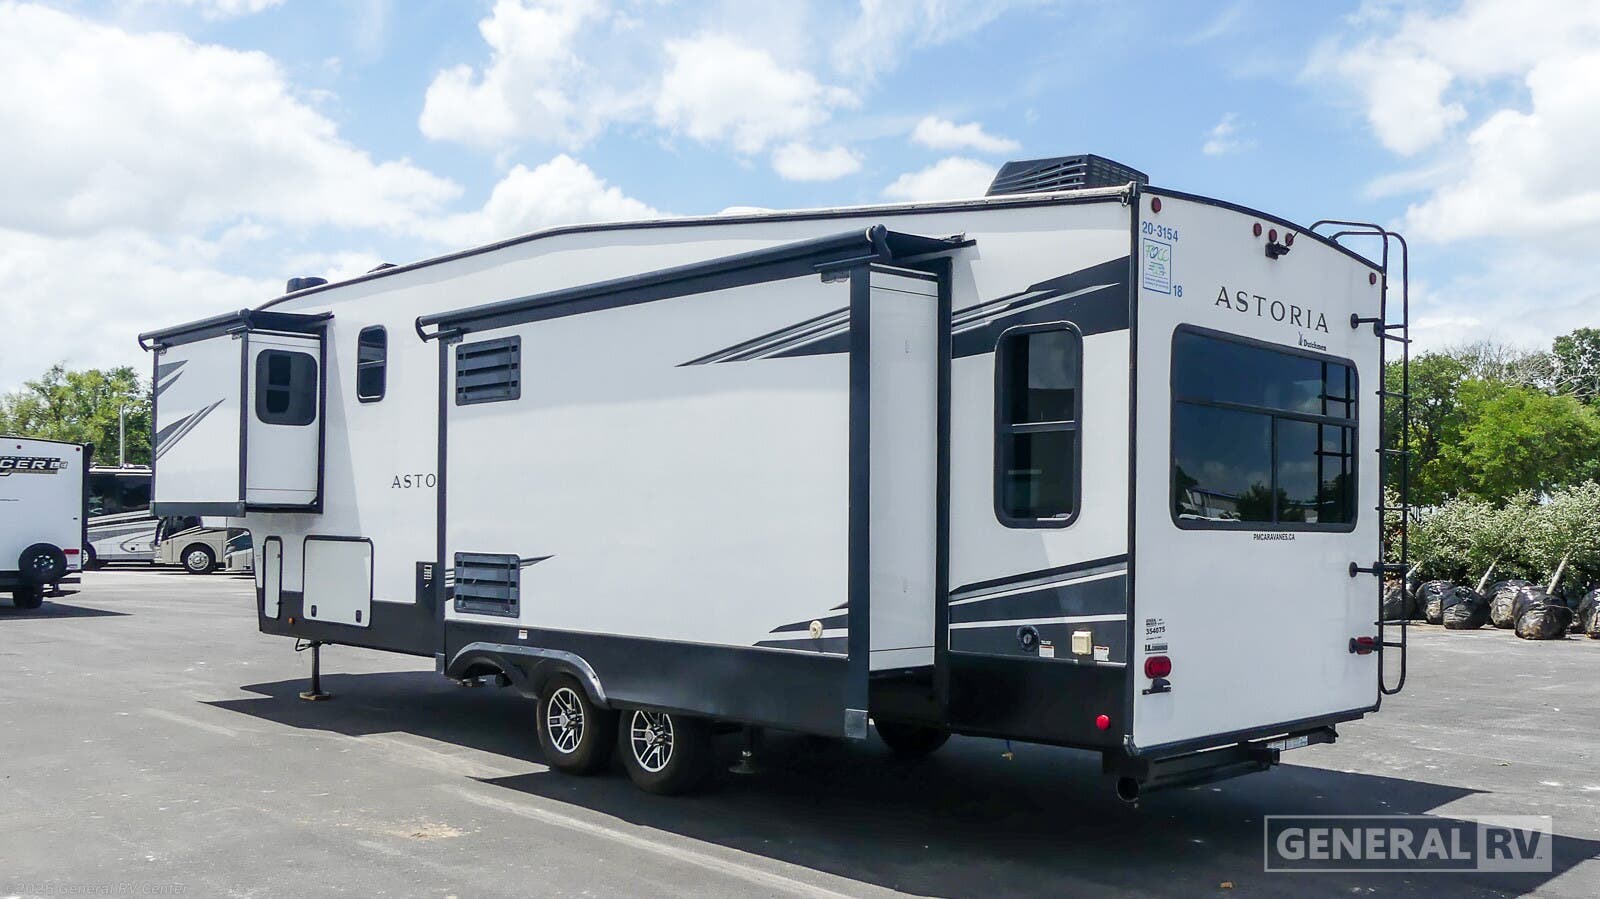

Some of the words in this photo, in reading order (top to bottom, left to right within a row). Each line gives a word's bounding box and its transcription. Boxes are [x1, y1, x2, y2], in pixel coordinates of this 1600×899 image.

[1142, 221, 1179, 242] 20-3154
[1173, 284, 1183, 297] 18
[1215, 286, 1329, 333] ASTORIA
[391, 473, 436, 488] ASTO
